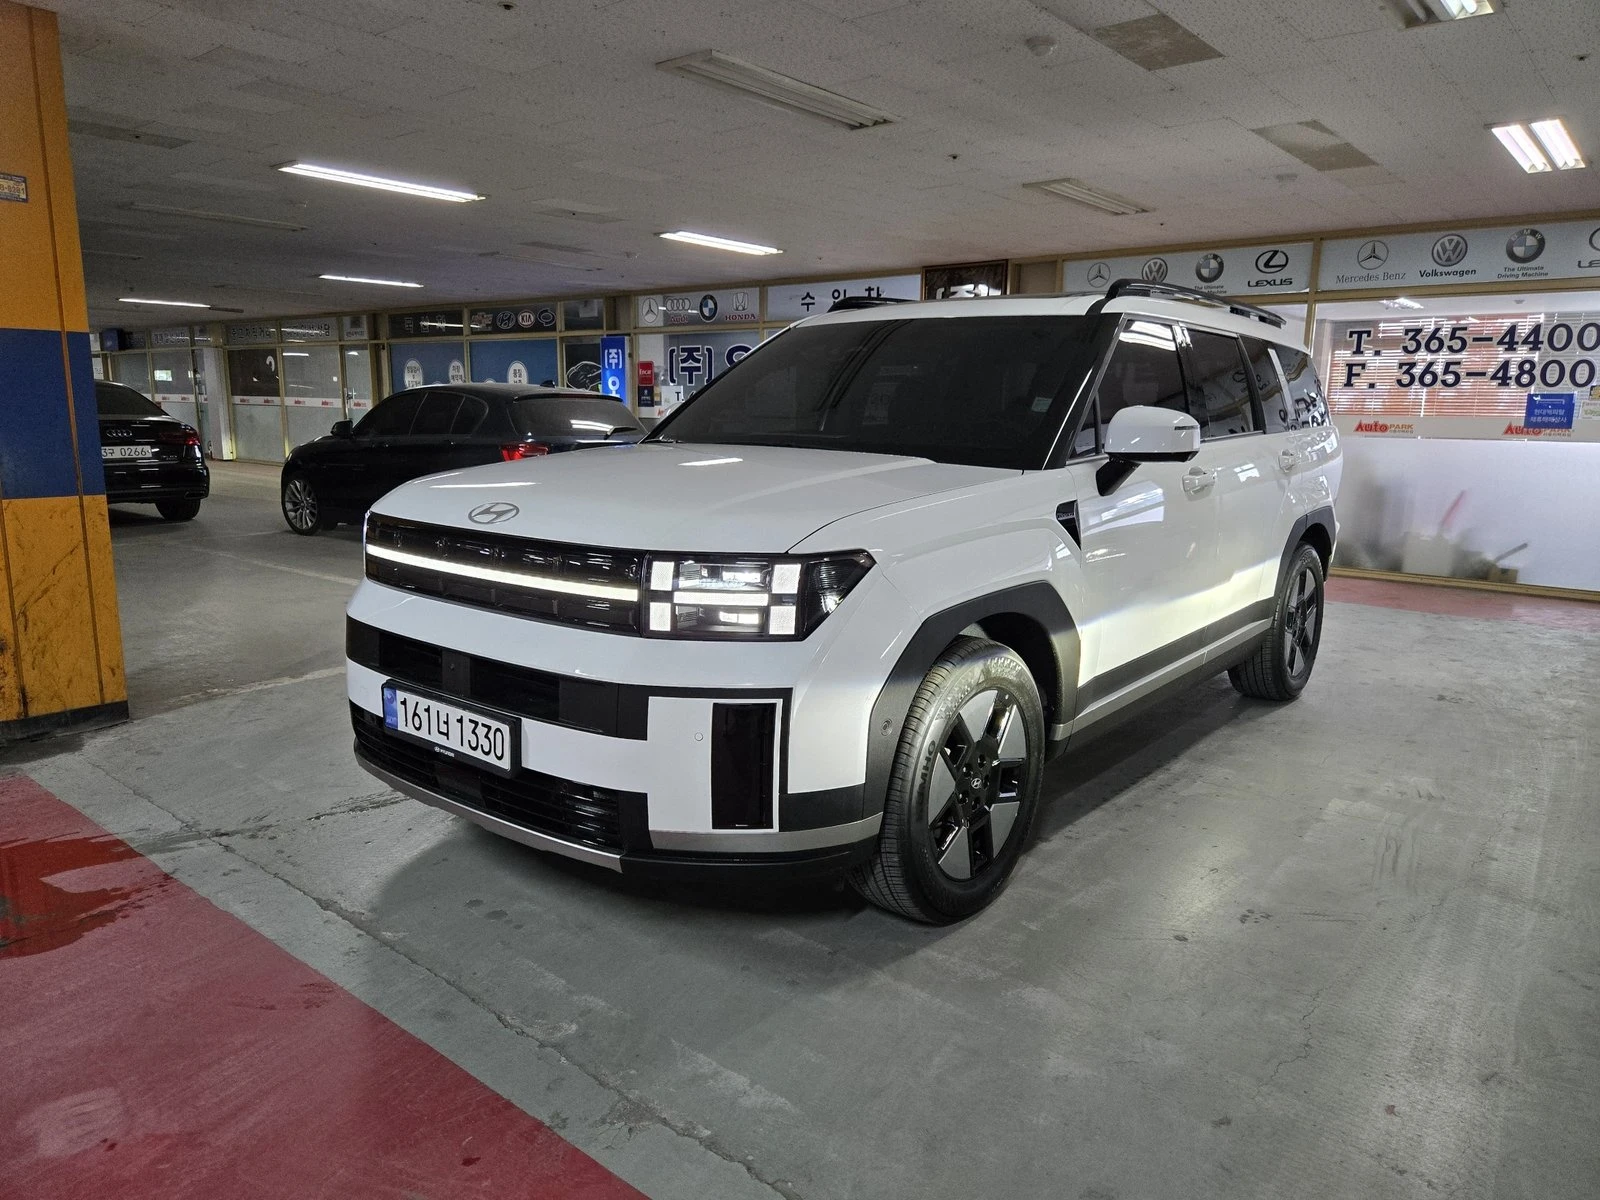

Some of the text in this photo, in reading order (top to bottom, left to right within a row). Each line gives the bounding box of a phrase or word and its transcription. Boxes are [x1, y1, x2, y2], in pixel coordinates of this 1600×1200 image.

[1335, 271, 1407, 285] Mercedes Benz
[1419, 268, 1477, 279] Volkswagen
[1247, 277, 1293, 288] LEXUS
[520, 314, 532, 325] KIA
[670, 315, 689, 323] Audi
[725, 313, 756, 321] HONDA
[1348, 322, 1600, 355] T. 365-4400
[604, 348, 622, 369] (주)
[668, 345, 714, 386] (주)
[1343, 359, 1596, 389] F. 365-4800
[1354, 420, 1389, 432] Auto
[119, 447, 147, 457] 0266
